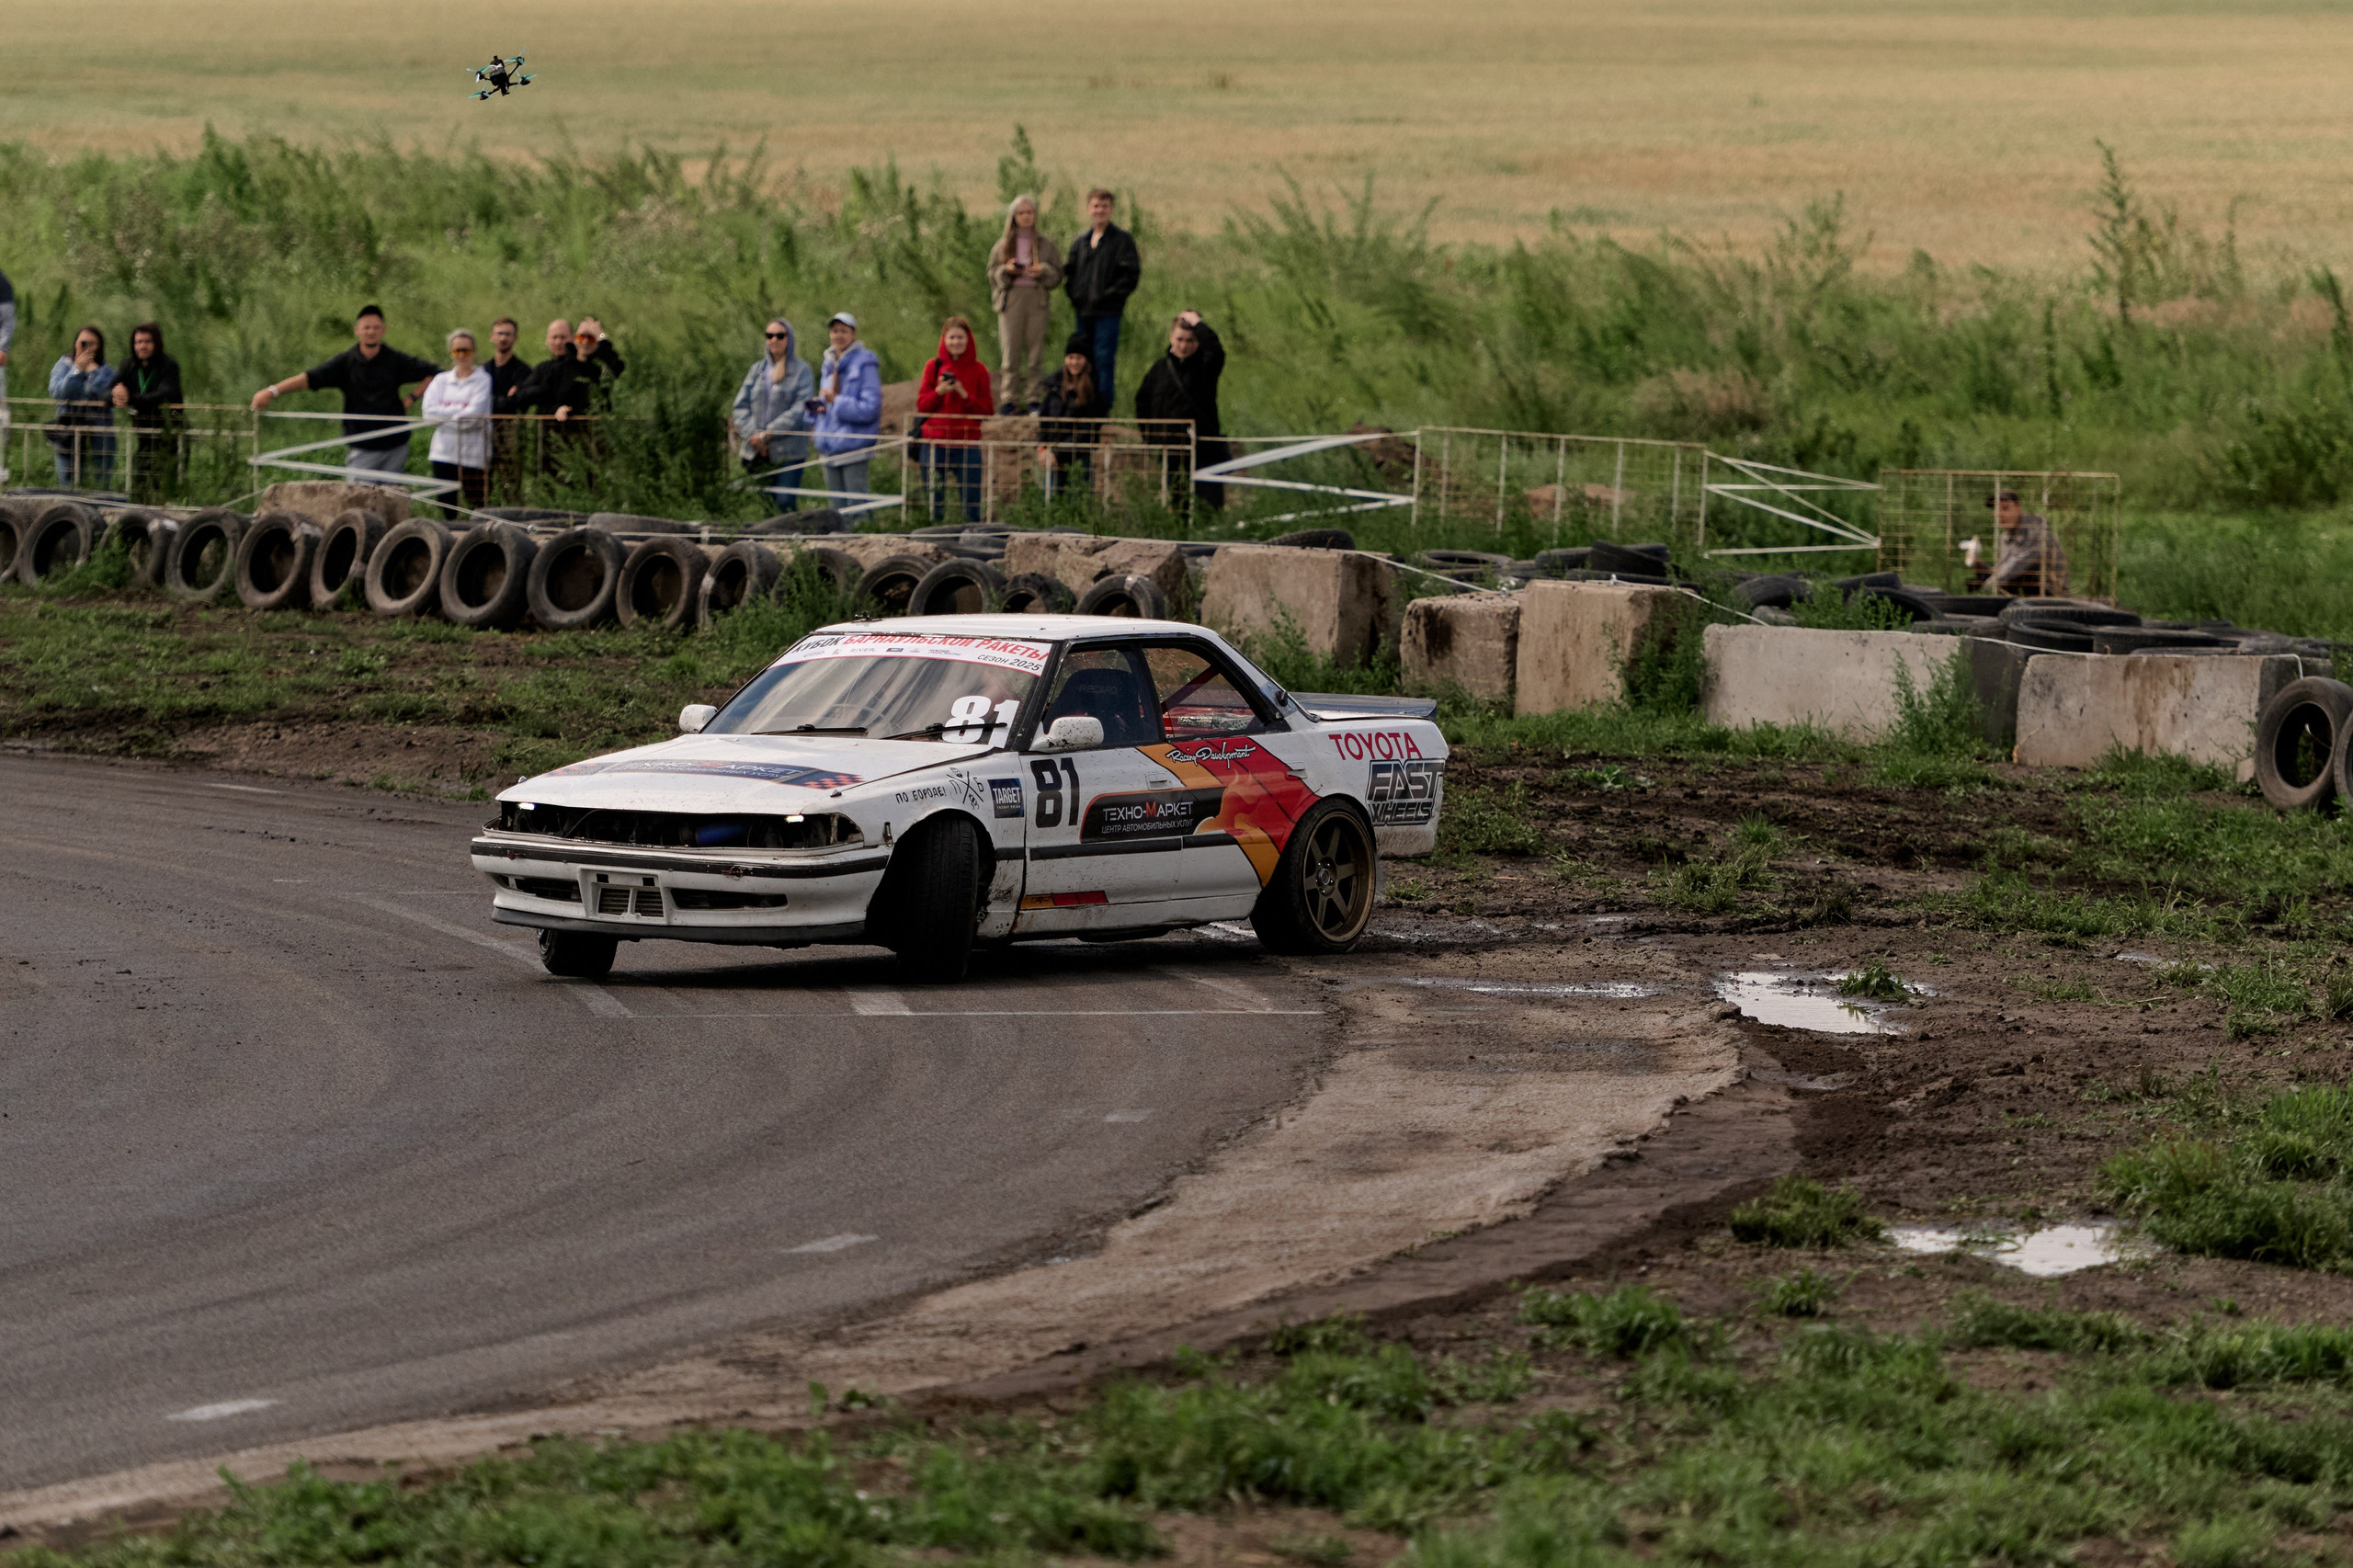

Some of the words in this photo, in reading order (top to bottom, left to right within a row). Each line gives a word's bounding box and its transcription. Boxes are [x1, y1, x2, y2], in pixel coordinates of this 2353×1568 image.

[791, 636, 846, 653] КУБОК
[974, 640, 1051, 661] РАКЕТЫ
[977, 653, 1010, 665] СЕЗОН
[1009, 658, 1044, 672] 2025
[941, 695, 1020, 749] 81
[1165, 747, 1199, 766] Racing
[1327, 732, 1423, 761] TOYOTA
[1366, 760, 1445, 801] FAST
[895, 792, 909, 804] ПО
[913, 787, 946, 801] БОРОДЕ!
[992, 787, 1021, 805] TARGET
[1029, 756, 1081, 828] 81
[1103, 801, 1194, 822] ТЕХНО-МАРКЕТ
[1367, 801, 1435, 825] WHEELS
[1101, 825, 1122, 834] ЦЕНТР
[1121, 820, 1176, 832] АВТОМОБИЛЬНЫХ
[1176, 818, 1194, 827] УСЛУГ
